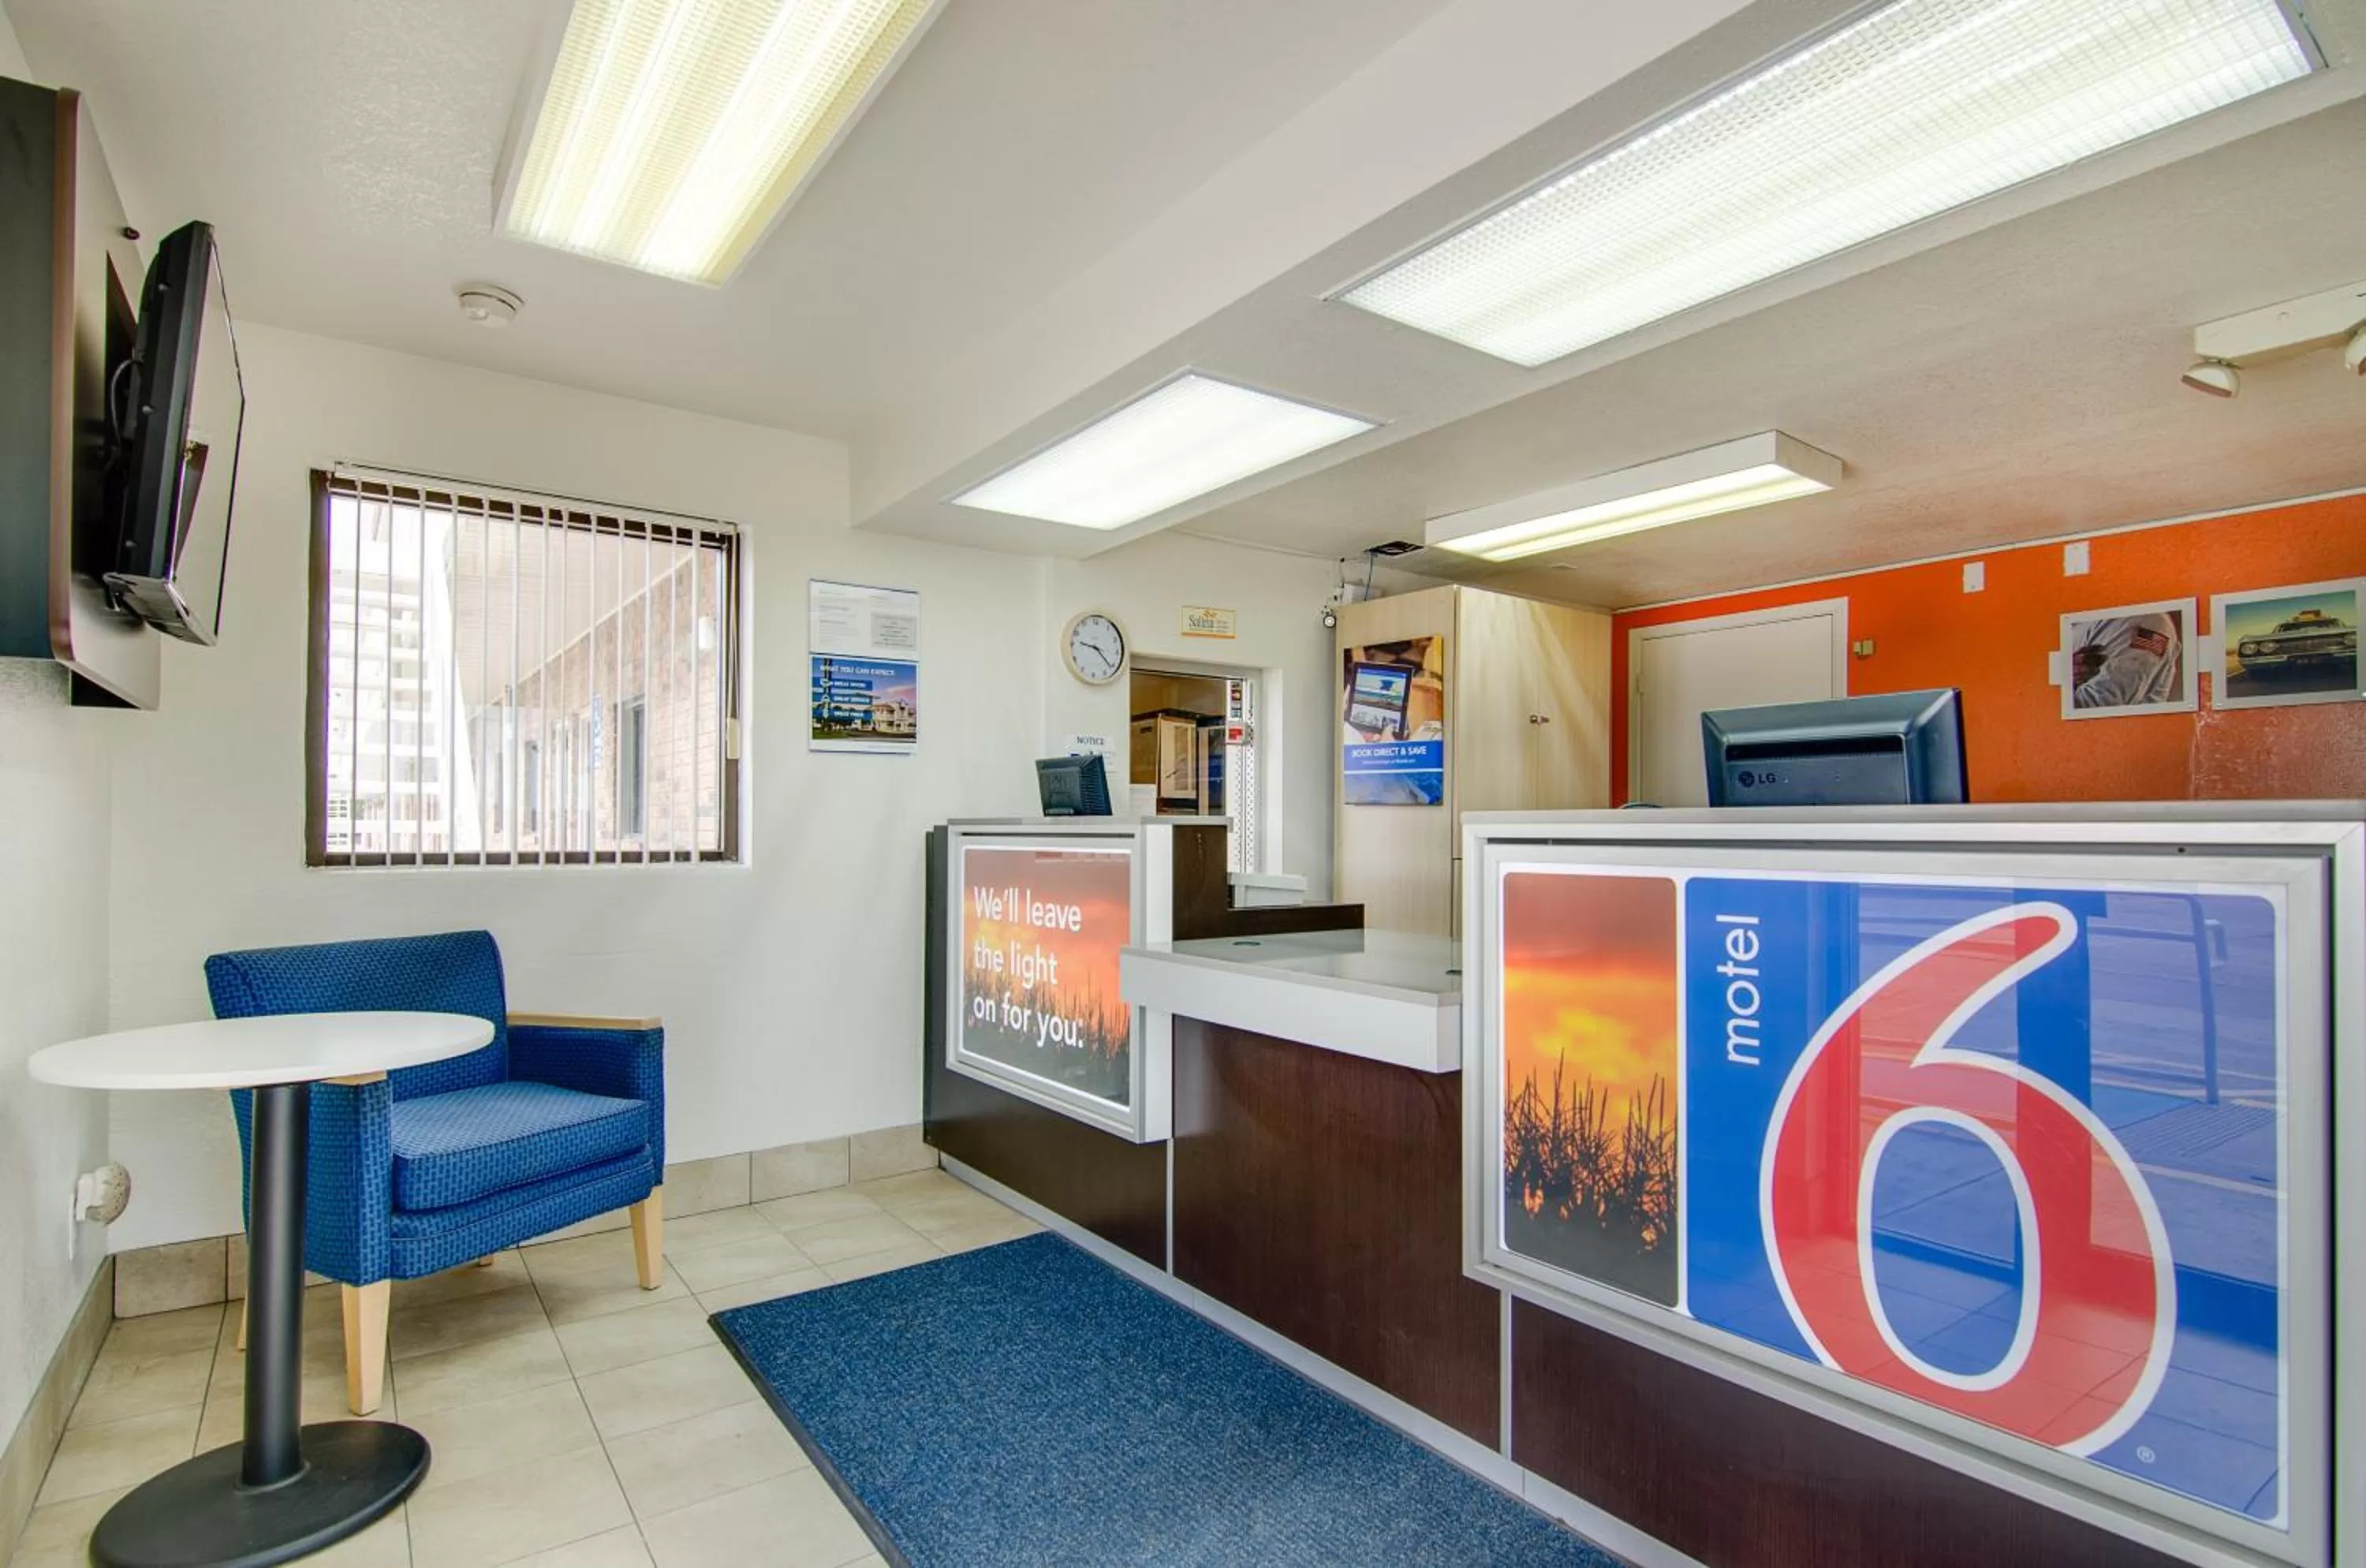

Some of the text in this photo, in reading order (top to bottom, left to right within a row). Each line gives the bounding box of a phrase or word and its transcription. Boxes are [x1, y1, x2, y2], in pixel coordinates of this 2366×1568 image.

[1373, 747, 1399, 756] DIRECT
[1408, 745, 1427, 755] SAVE
[1758, 773, 1776, 783] LG
[974, 886, 1082, 931] We'll leave
[974, 936, 1058, 989] the light
[973, 995, 996, 1023] on
[1002, 991, 1032, 1032] for
[1715, 914, 1760, 1066] motel
[1760, 901, 2178, 1458] 6
